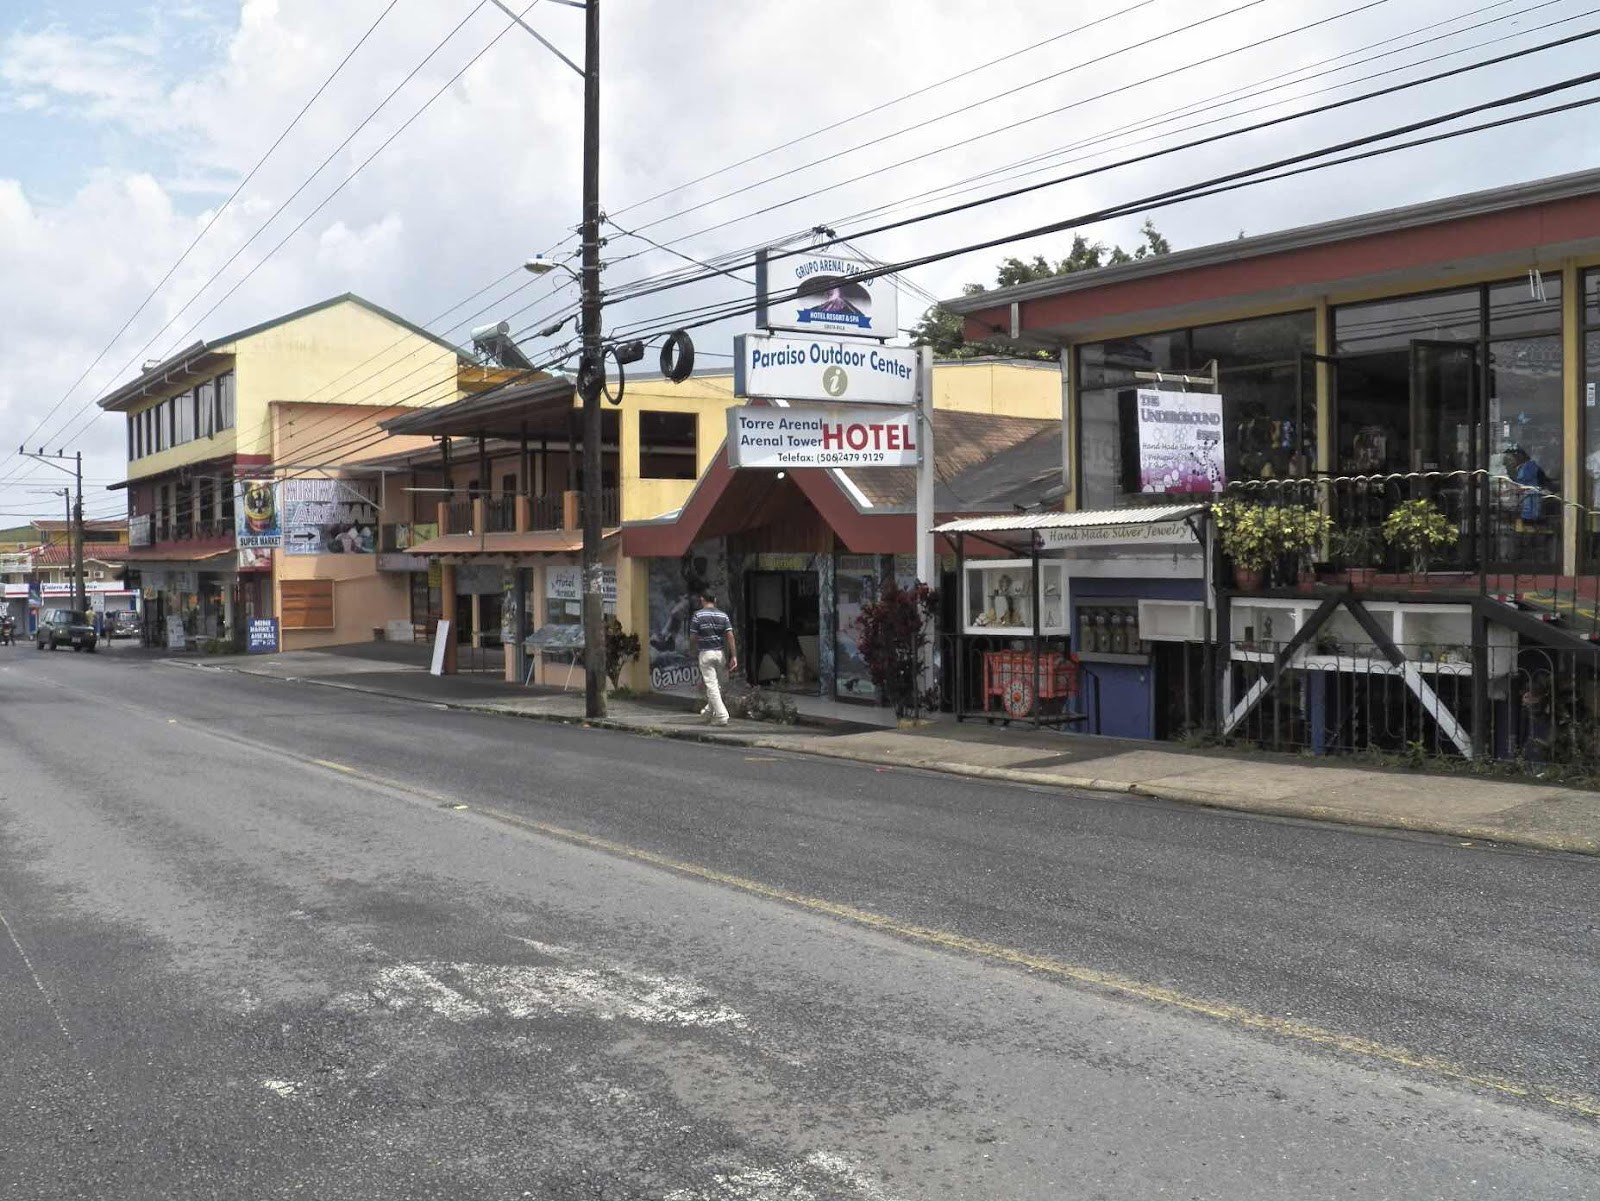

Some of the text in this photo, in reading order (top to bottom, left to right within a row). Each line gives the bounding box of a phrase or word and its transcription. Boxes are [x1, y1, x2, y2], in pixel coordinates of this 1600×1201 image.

[795, 260, 819, 279] GRUPO
[820, 259, 845, 274] ARENAL
[810, 311, 826, 320] HOTEL
[827, 313, 845, 322] RESORT
[850, 314, 859, 322] SPA
[752, 343, 912, 379] Paraiso Outdoor Center
[739, 417, 823, 430] Torre Arenal
[741, 435, 824, 447] Arenal Tower
[823, 423, 916, 451] HOTEL
[777, 453, 814, 462] Telefax:
[862, 453, 884, 462] 9129
[1050, 524, 1188, 541] Hand Made Silver Jewelry
[240, 536, 281, 546] SUPER MARKET
[254, 619, 271, 627] MINI
[652, 665, 702, 688] Canop
